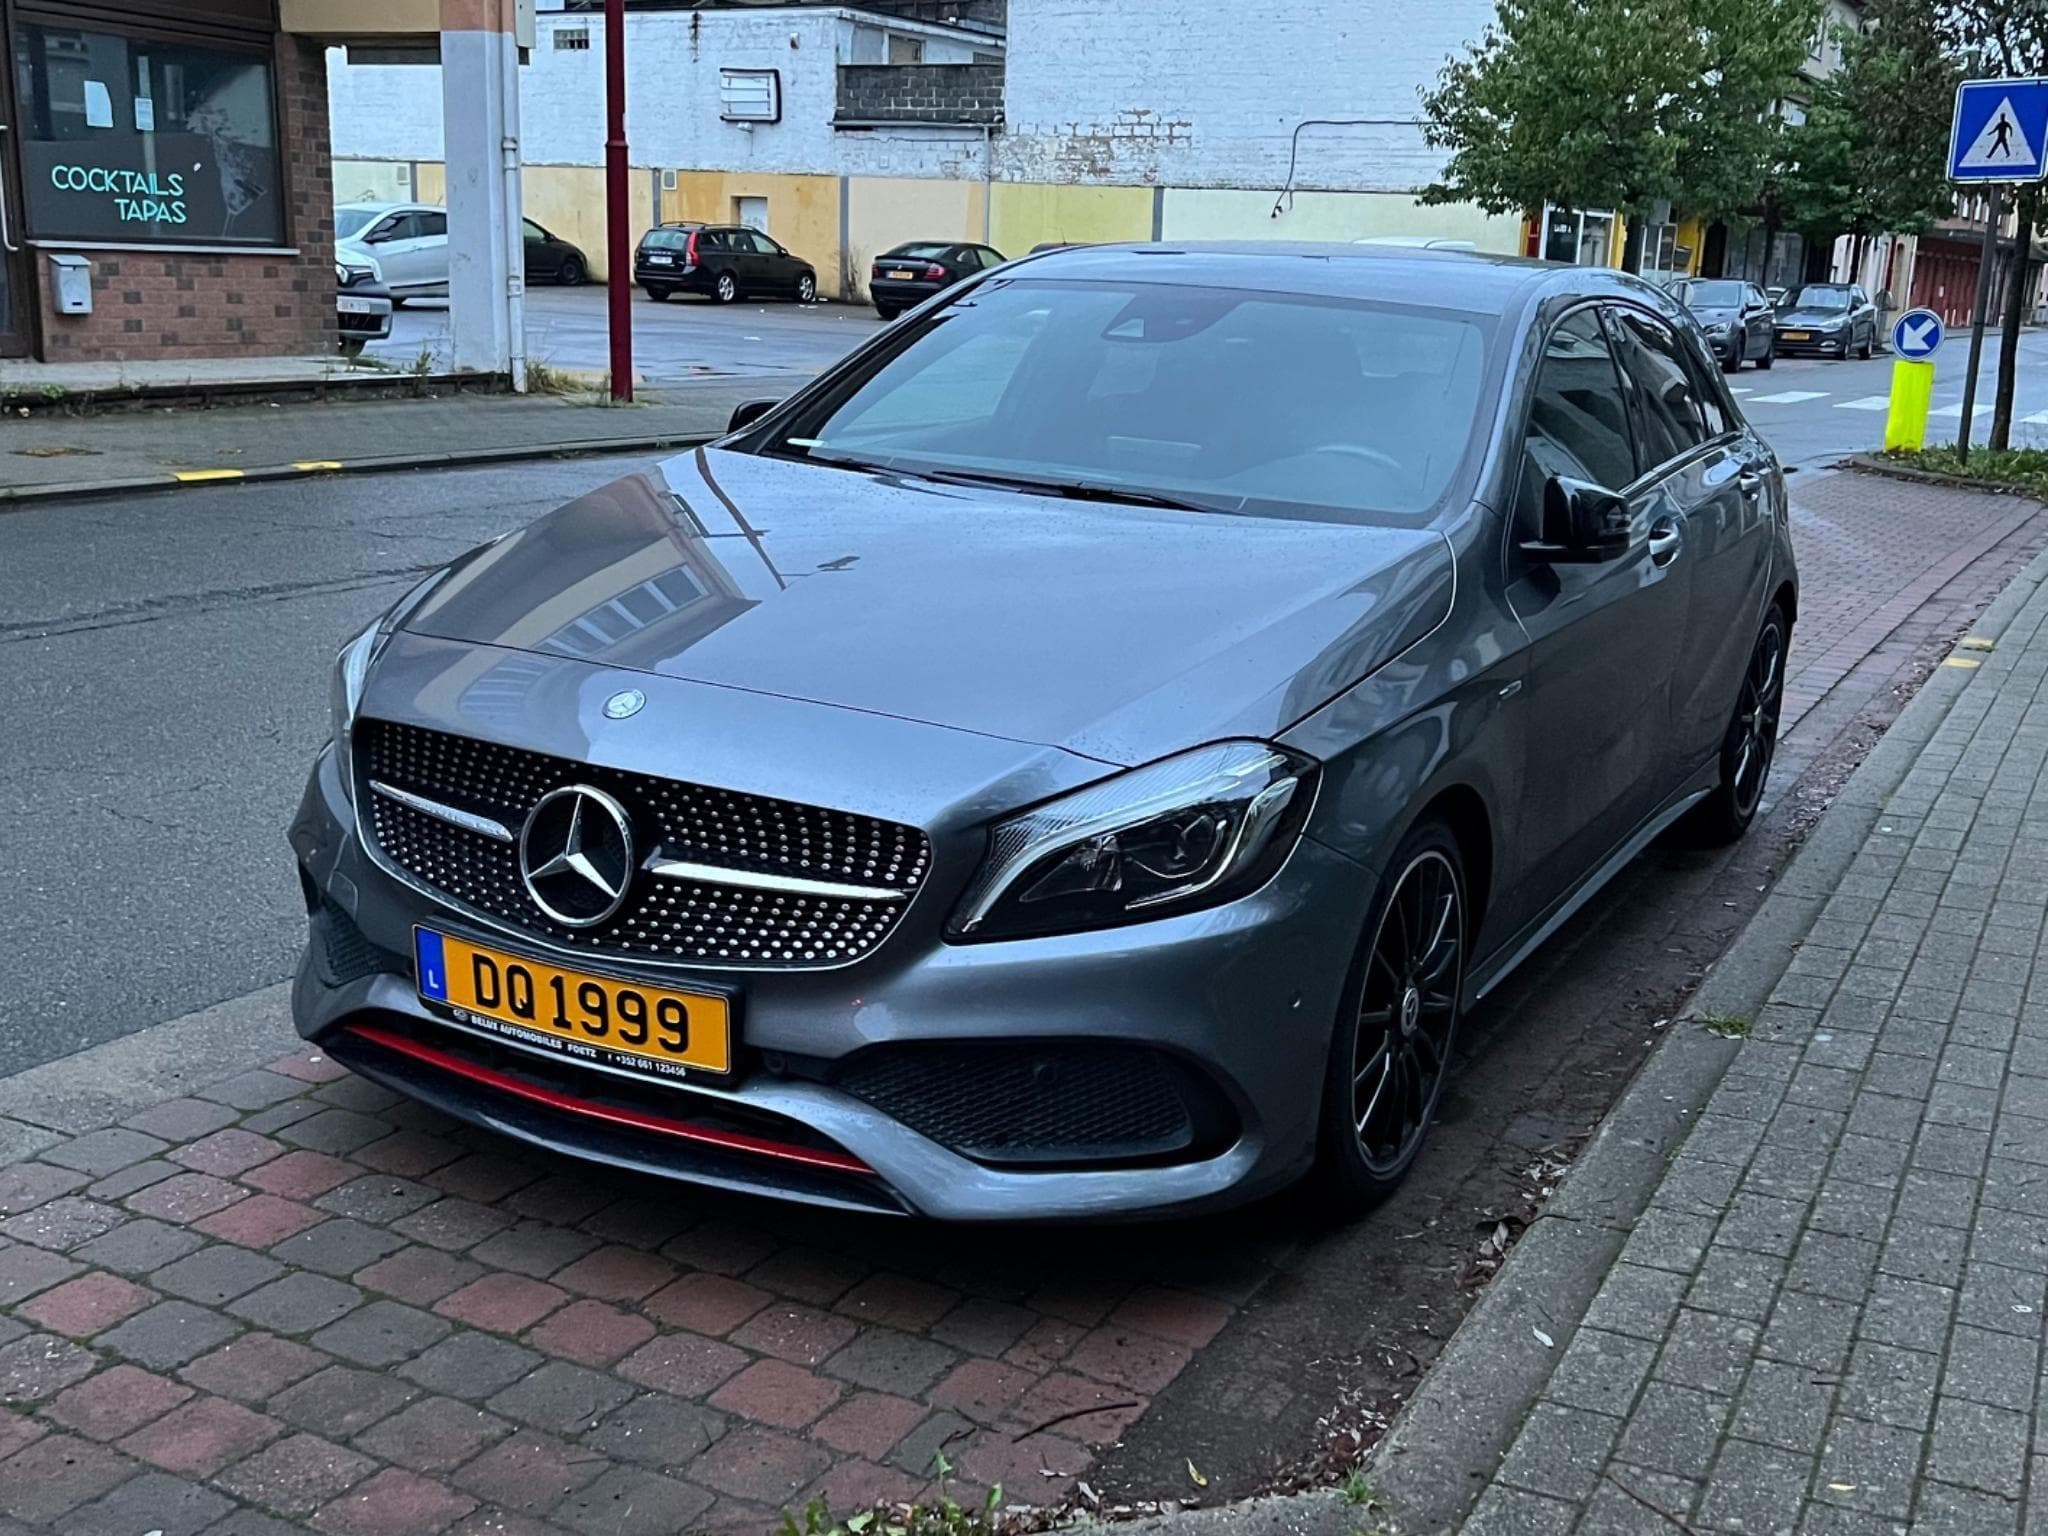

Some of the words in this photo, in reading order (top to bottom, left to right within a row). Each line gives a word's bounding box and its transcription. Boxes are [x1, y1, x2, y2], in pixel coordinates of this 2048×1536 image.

[52, 165, 184, 197] COCKTAILS
[114, 198, 187, 224] TAPAS
[428, 969, 439, 989] L
[500, 1023, 563, 1049] AUTOMOBILES
[567, 1043, 597, 1058] FOETZ
